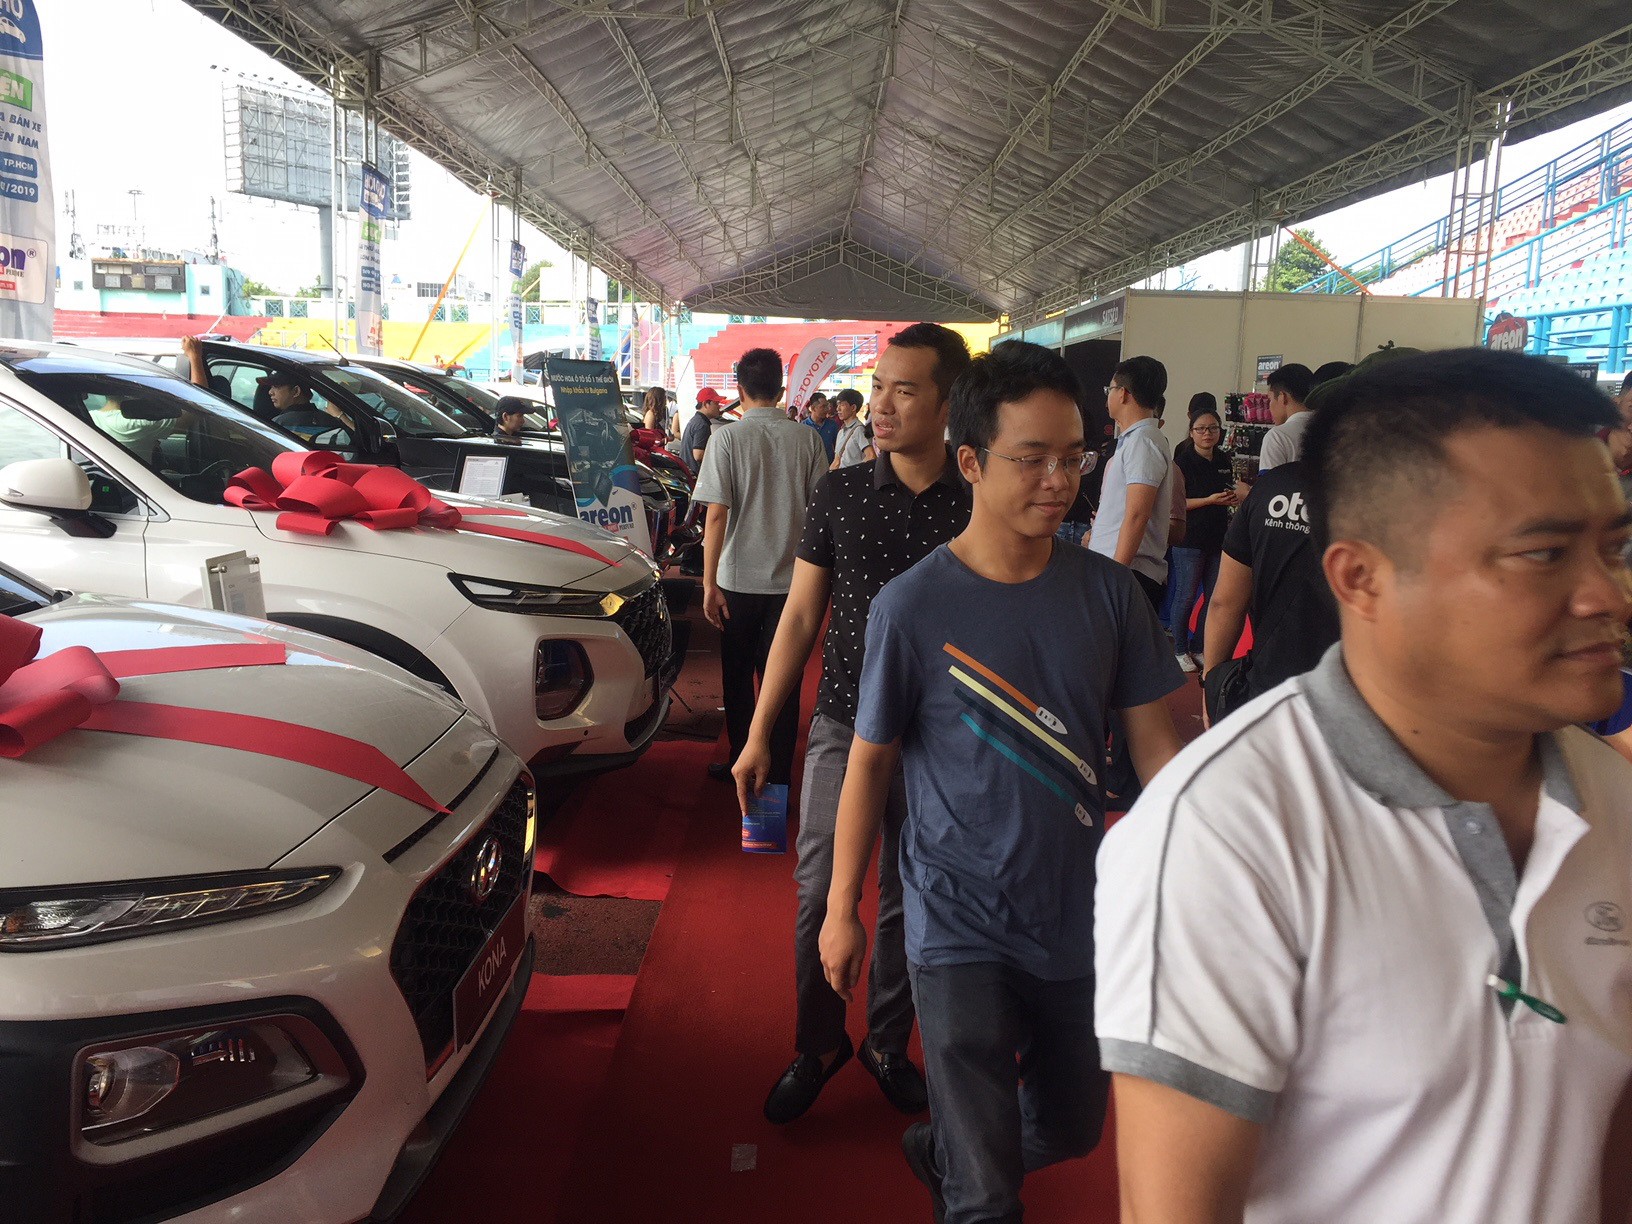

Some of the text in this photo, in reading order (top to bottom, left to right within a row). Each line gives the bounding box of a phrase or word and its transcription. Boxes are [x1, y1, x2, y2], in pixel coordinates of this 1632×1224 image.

[9, 113, 30, 129] BÁN
[32, 122, 42, 133] XE
[17, 135, 39, 149] NAM
[1491, 327, 1524, 350] areon
[798, 350, 830, 393] TOYOTA
[1257, 360, 1281, 371] areon
[579, 504, 634, 527] areon
[1264, 518, 1311, 534] Kênh thông
[478, 936, 507, 997] KONA
